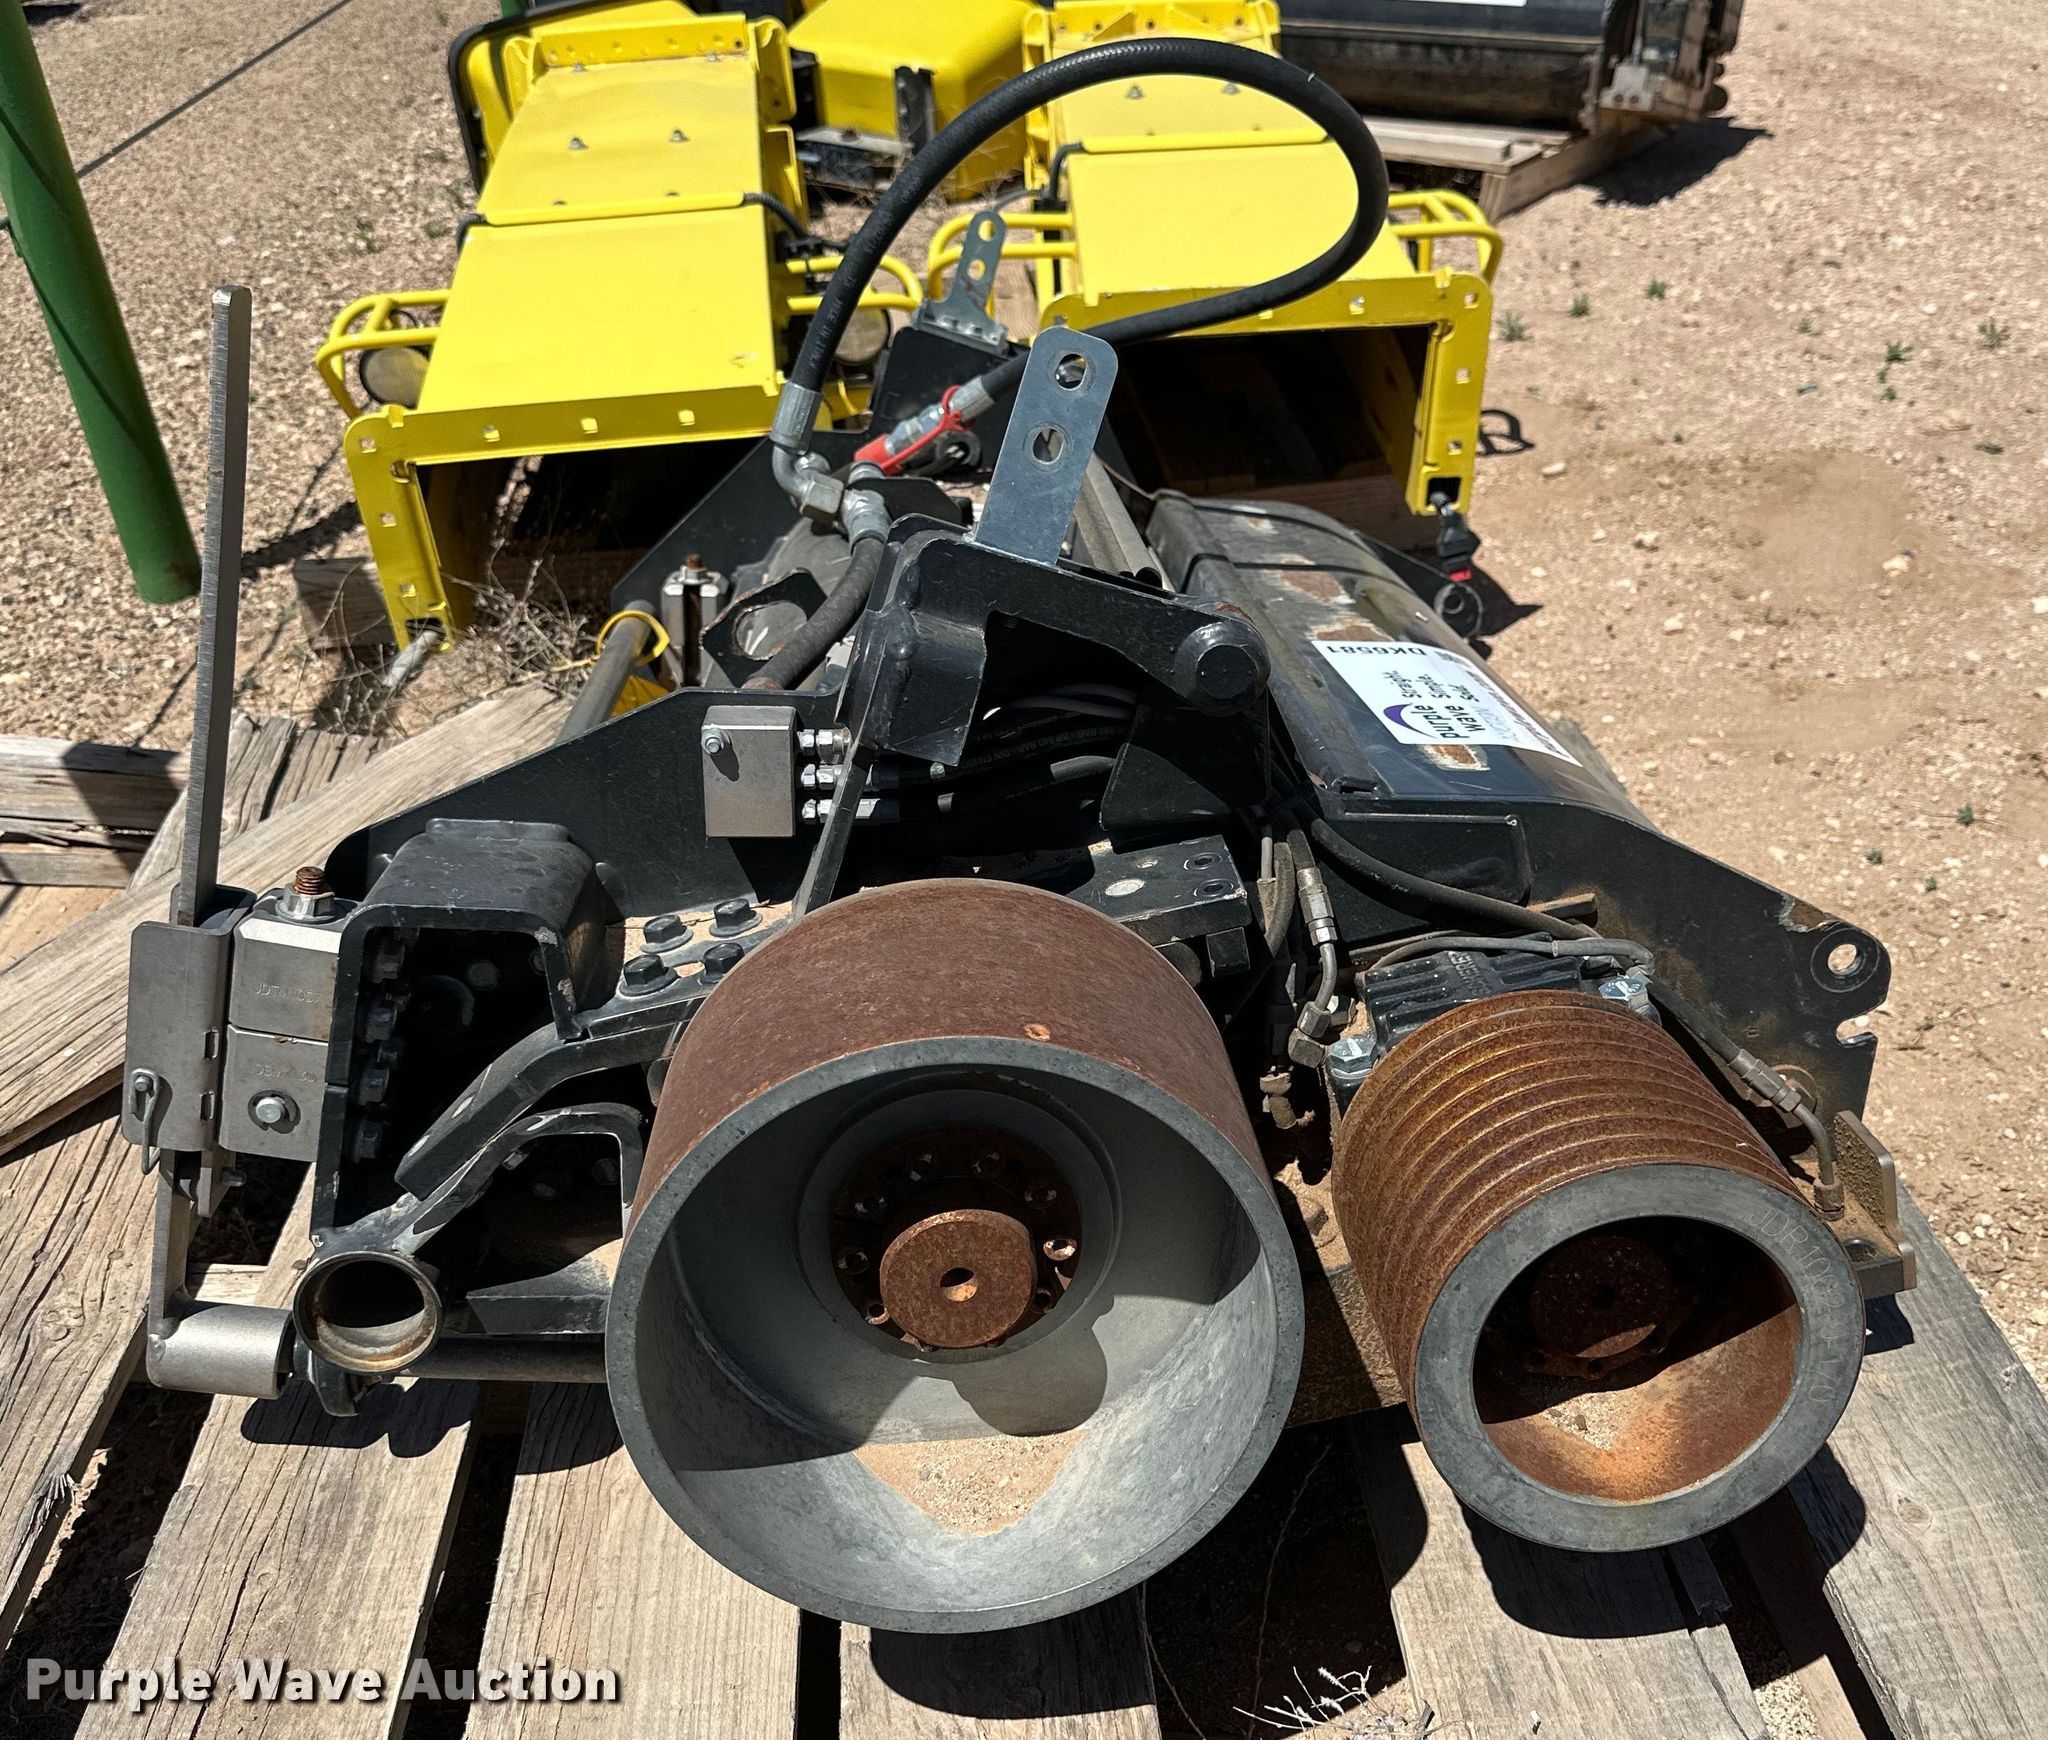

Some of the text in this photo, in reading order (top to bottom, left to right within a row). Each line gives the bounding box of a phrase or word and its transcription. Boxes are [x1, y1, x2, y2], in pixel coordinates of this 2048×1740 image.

[1326, 645, 1428, 656] DK6581
[1409, 704, 1471, 739] purple
[1444, 704, 1486, 733] wave
